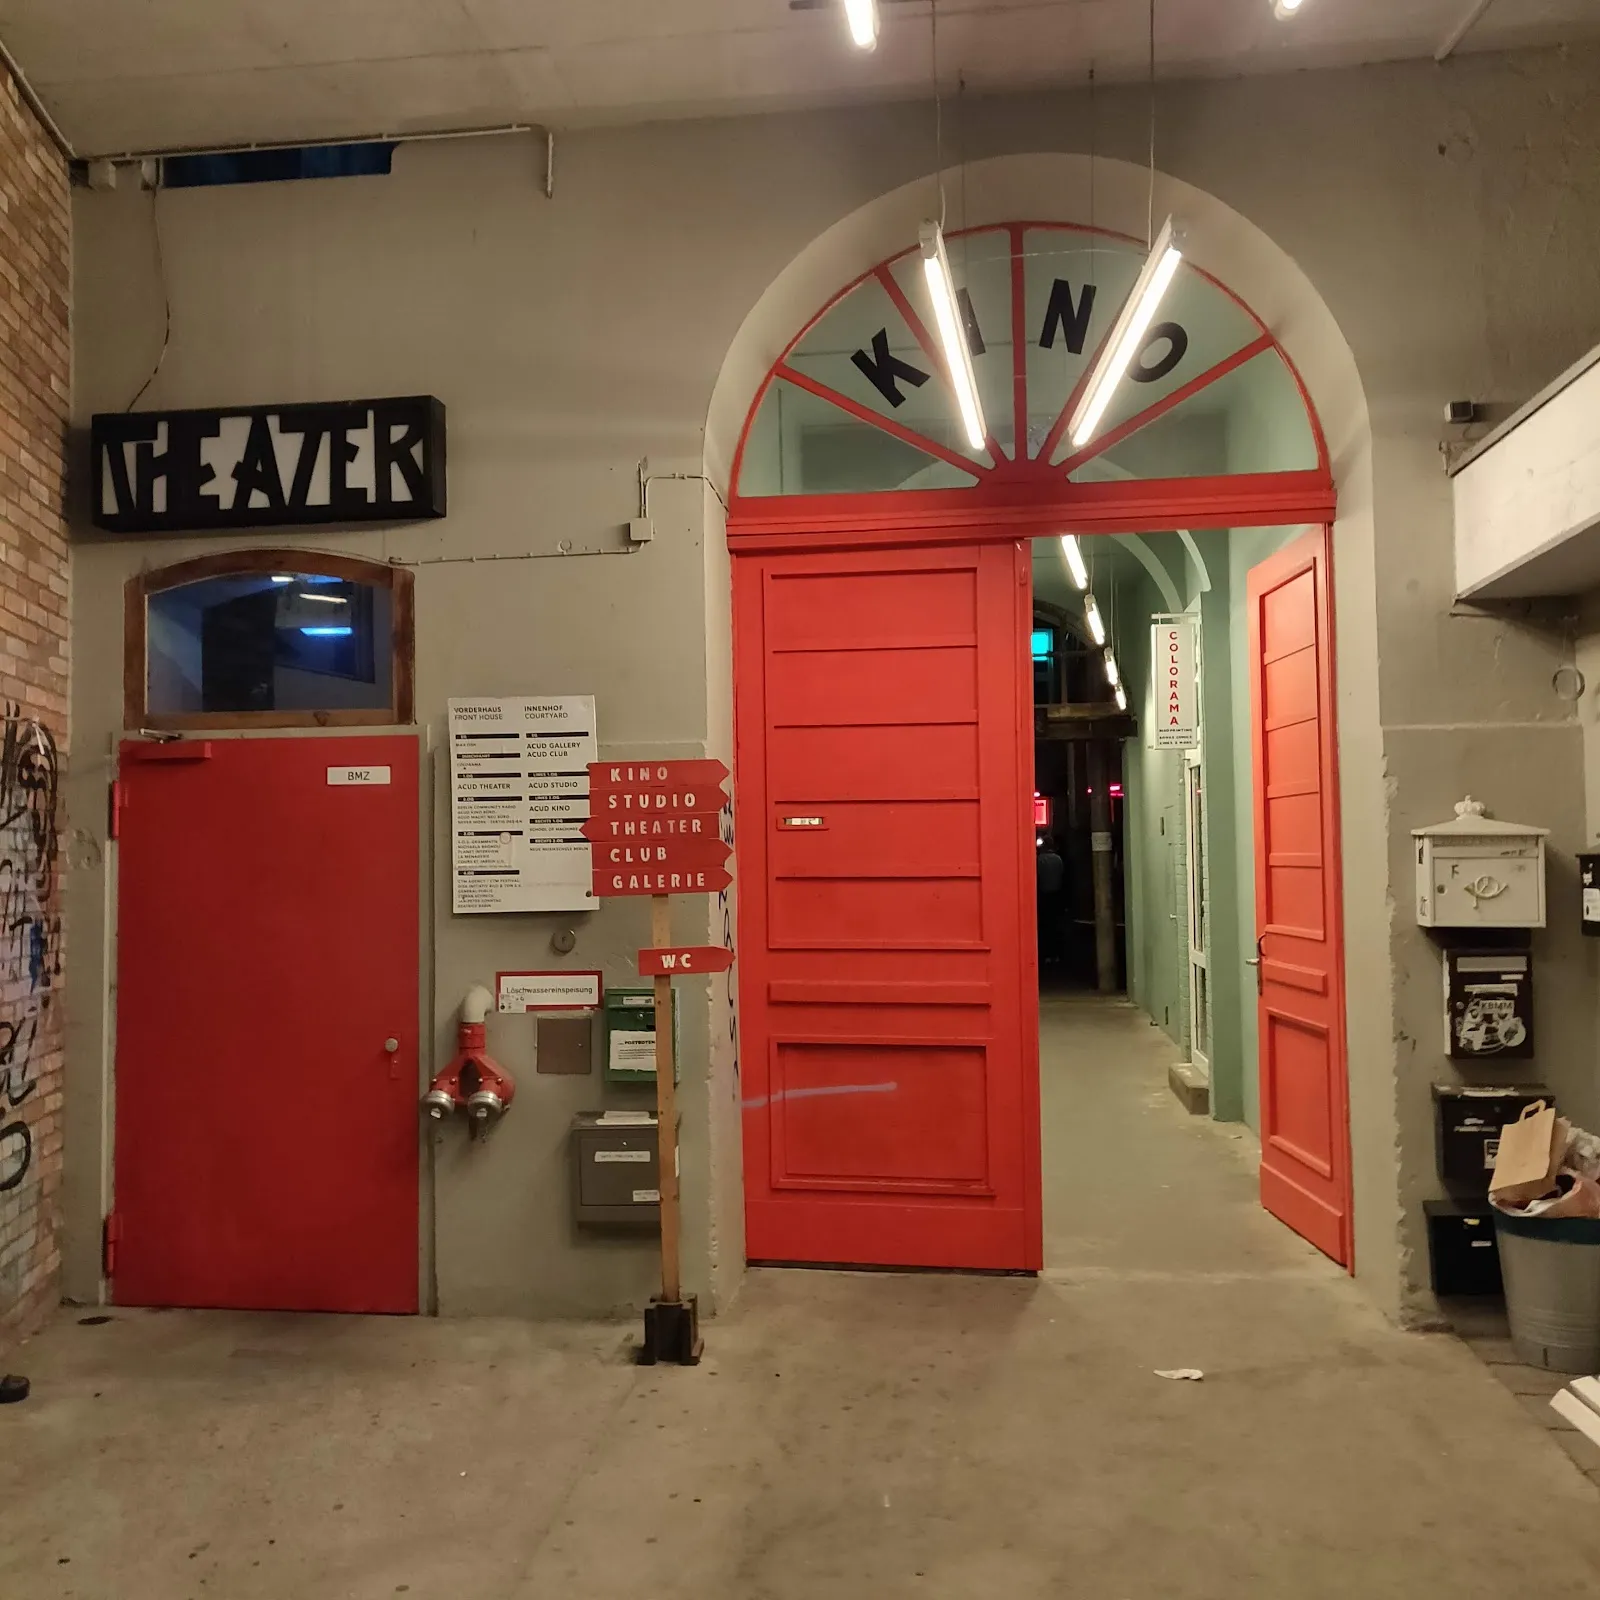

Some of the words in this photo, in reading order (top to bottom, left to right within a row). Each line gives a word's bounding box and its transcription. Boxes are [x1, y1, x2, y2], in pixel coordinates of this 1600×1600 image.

[850, 278, 1189, 409] KINO
[101, 409, 426, 516] THEATER
[1169, 631, 1179, 725] COLORAMA
[453, 706, 502, 714] VORDERHAUS
[524, 704, 563, 712] INNENHOF
[524, 712, 569, 720] COURTYARD
[347, 771, 371, 781] BMZ
[610, 767, 668, 782] KINO
[608, 793, 696, 809] STUDIO
[610, 819, 702, 835] THEATER
[610, 847, 667, 863] CLUB
[612, 872, 705, 889] GALERIE
[661, 953, 692, 969] WC
[506, 985, 593, 996] Löschwassereinspeisung
